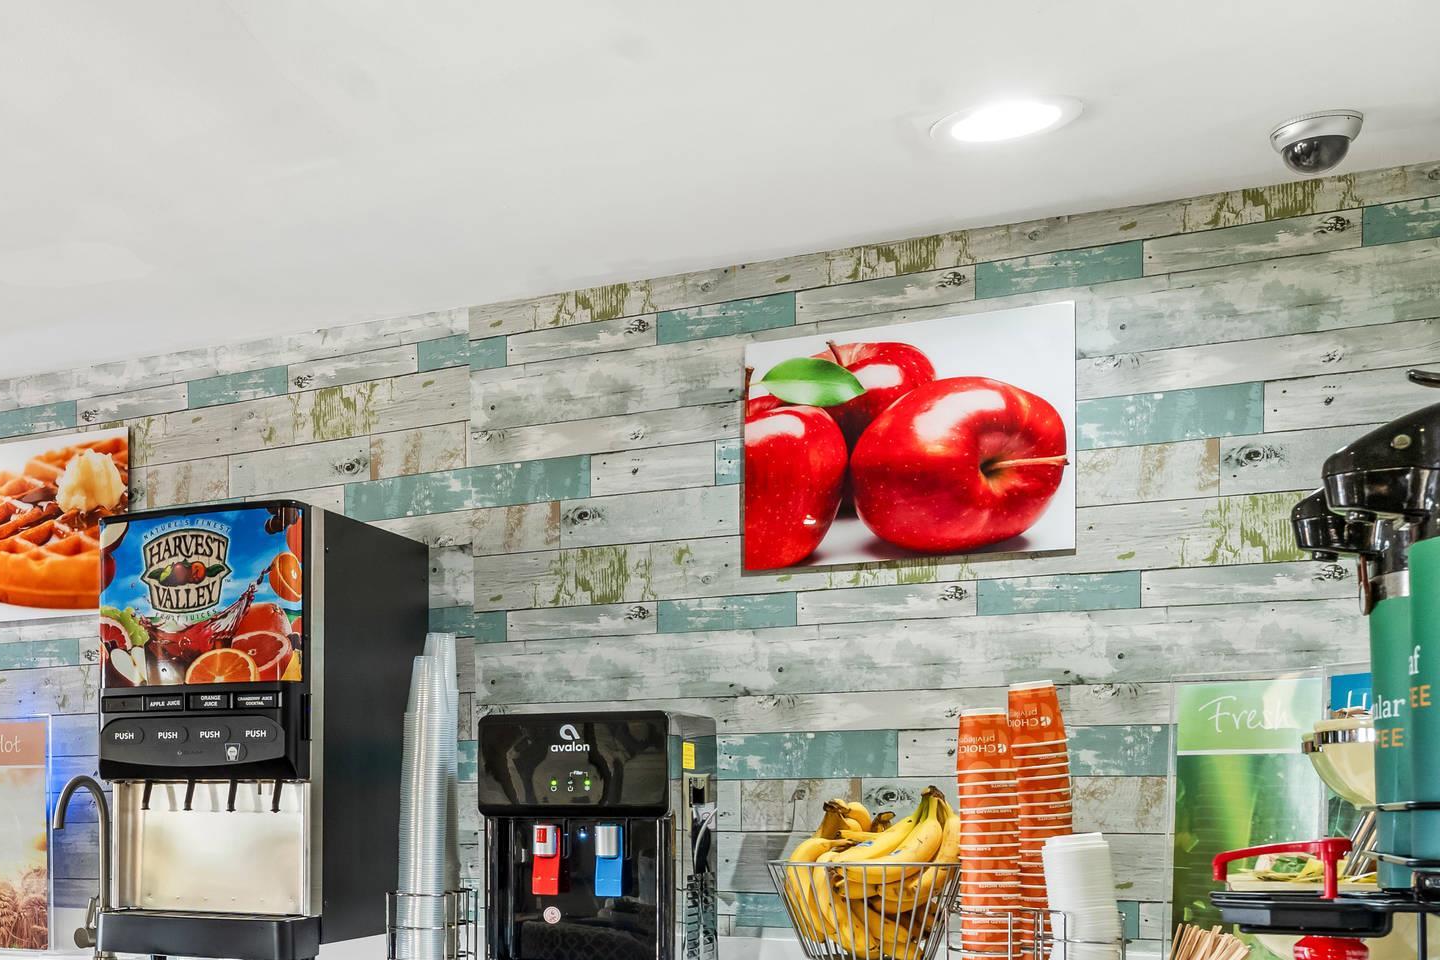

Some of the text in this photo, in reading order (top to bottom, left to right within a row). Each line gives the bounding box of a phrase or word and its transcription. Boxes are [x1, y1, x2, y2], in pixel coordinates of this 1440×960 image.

[144, 519, 231, 540] NATURE'S FINEST
[148, 533, 226, 568] HARVEST
[154, 580, 217, 609] VALLEY
[155, 609, 217, 622] FRUIT JUICES
[1198, 695, 1293, 734] Fresh
[114, 732, 135, 740] PUSH
[157, 732, 178, 740] PUSH
[199, 731, 221, 739] PUSH
[245, 730, 267, 738] PUSH
[550, 742, 591, 753] avalon
